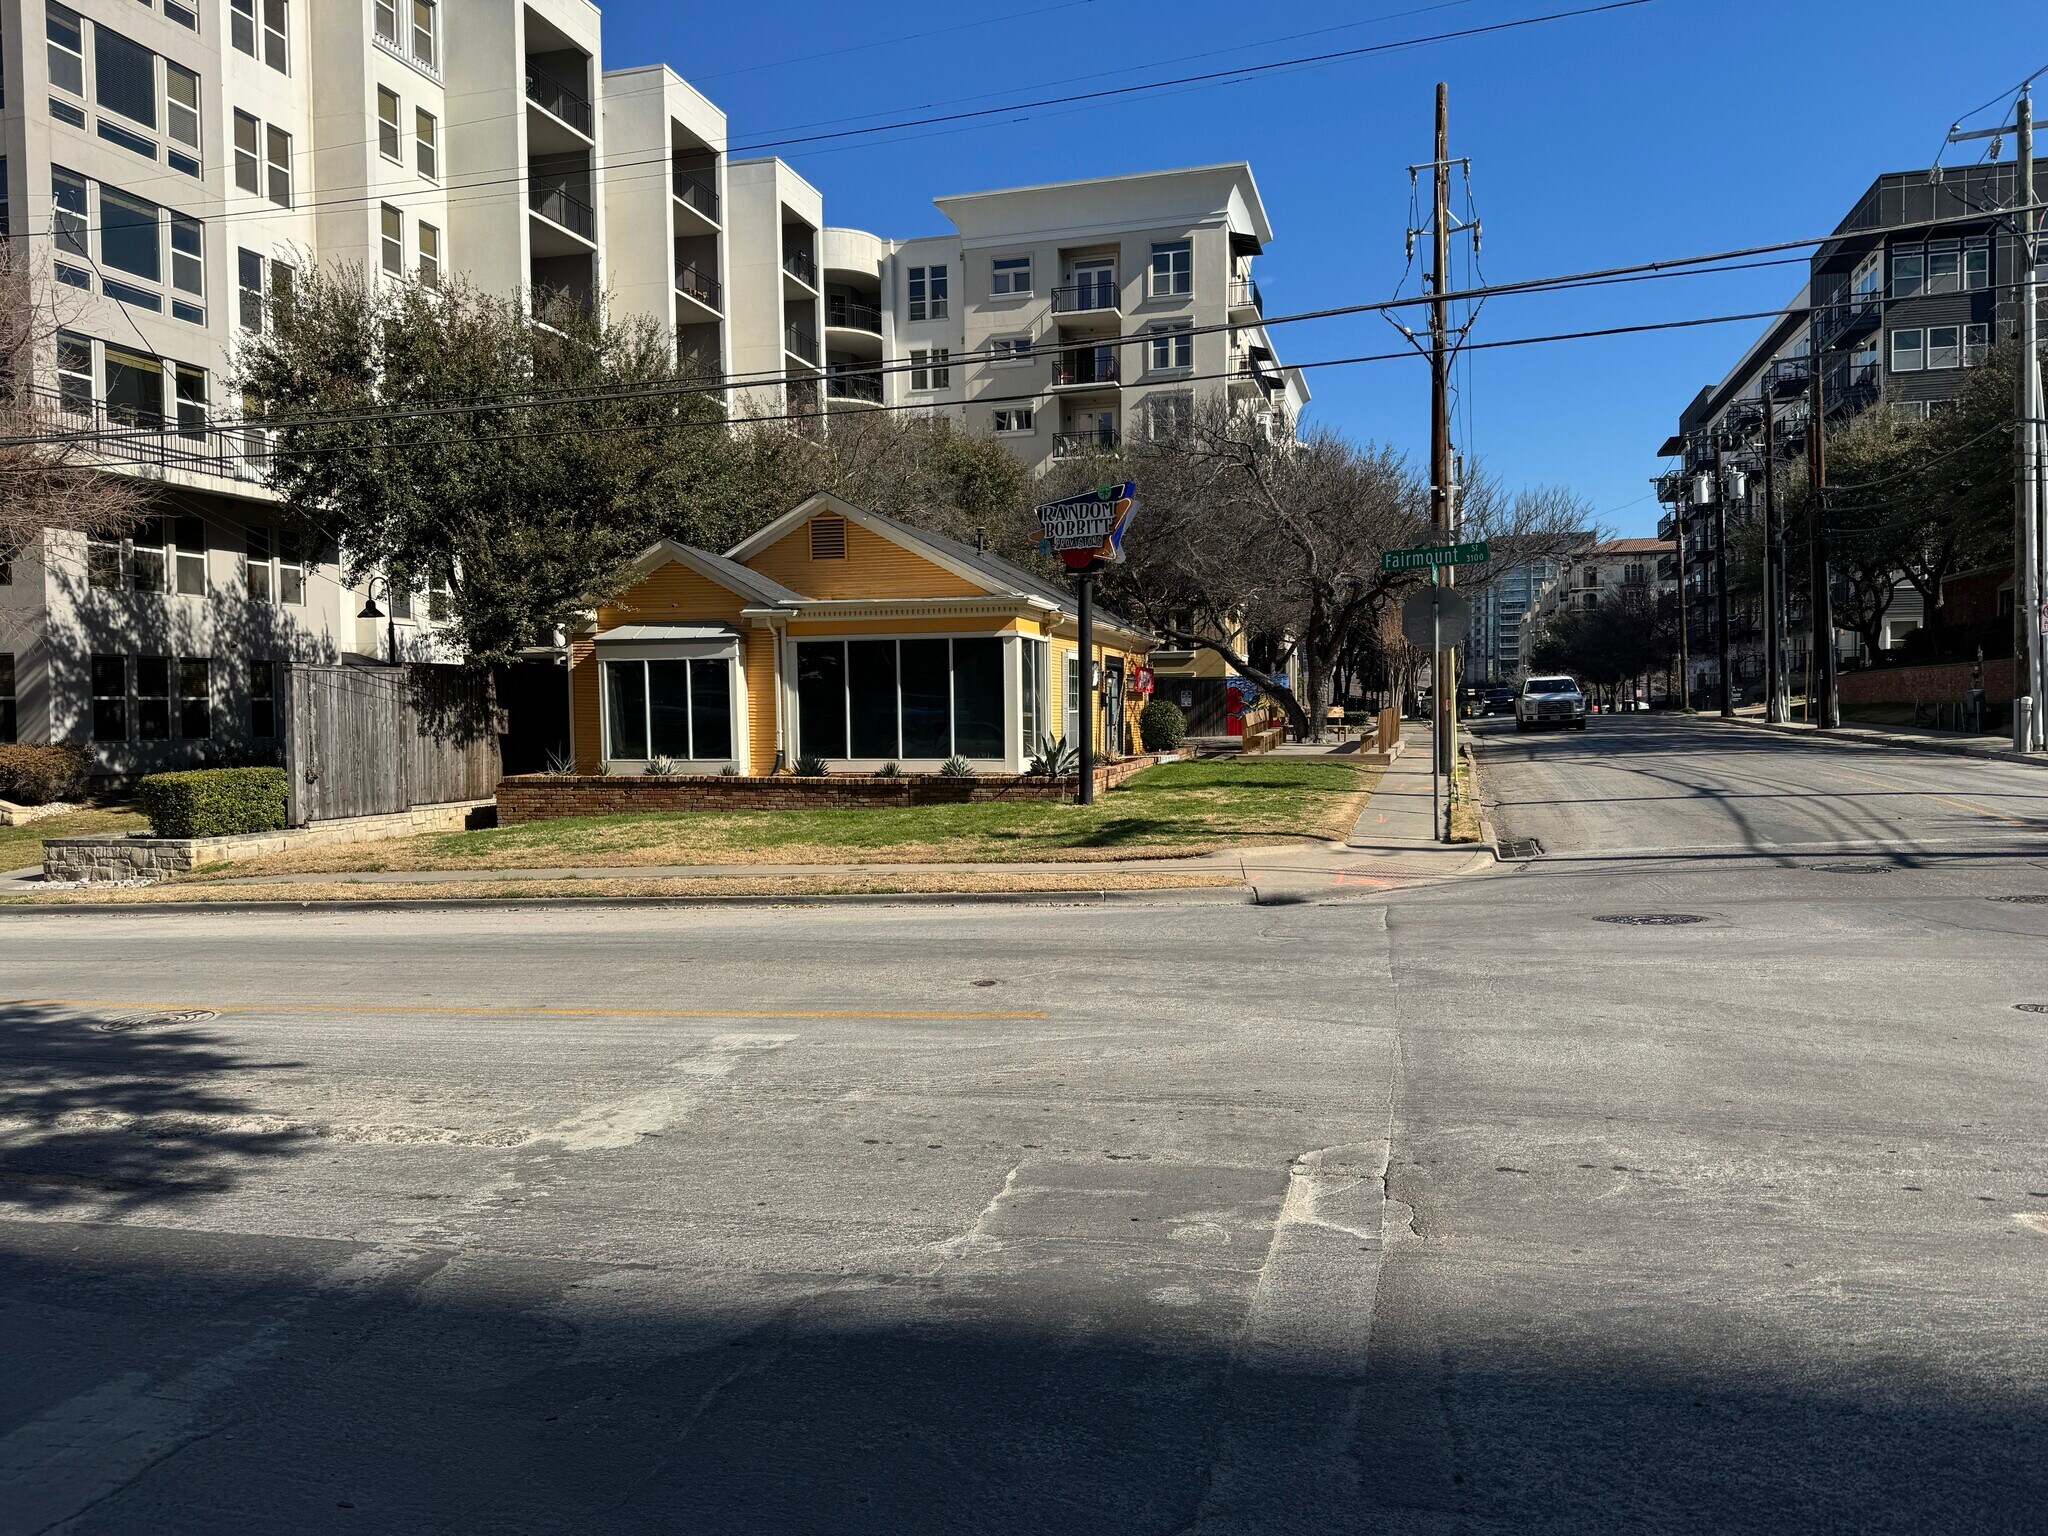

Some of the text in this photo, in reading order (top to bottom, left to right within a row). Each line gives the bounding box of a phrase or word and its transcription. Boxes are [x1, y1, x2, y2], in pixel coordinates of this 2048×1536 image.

[1043, 502, 1114, 521] RANDOM
[1046, 518, 1111, 537] BOBBITT
[1385, 544, 1478, 569] Fairmount St
[1466, 553, 1484, 562] 3100
